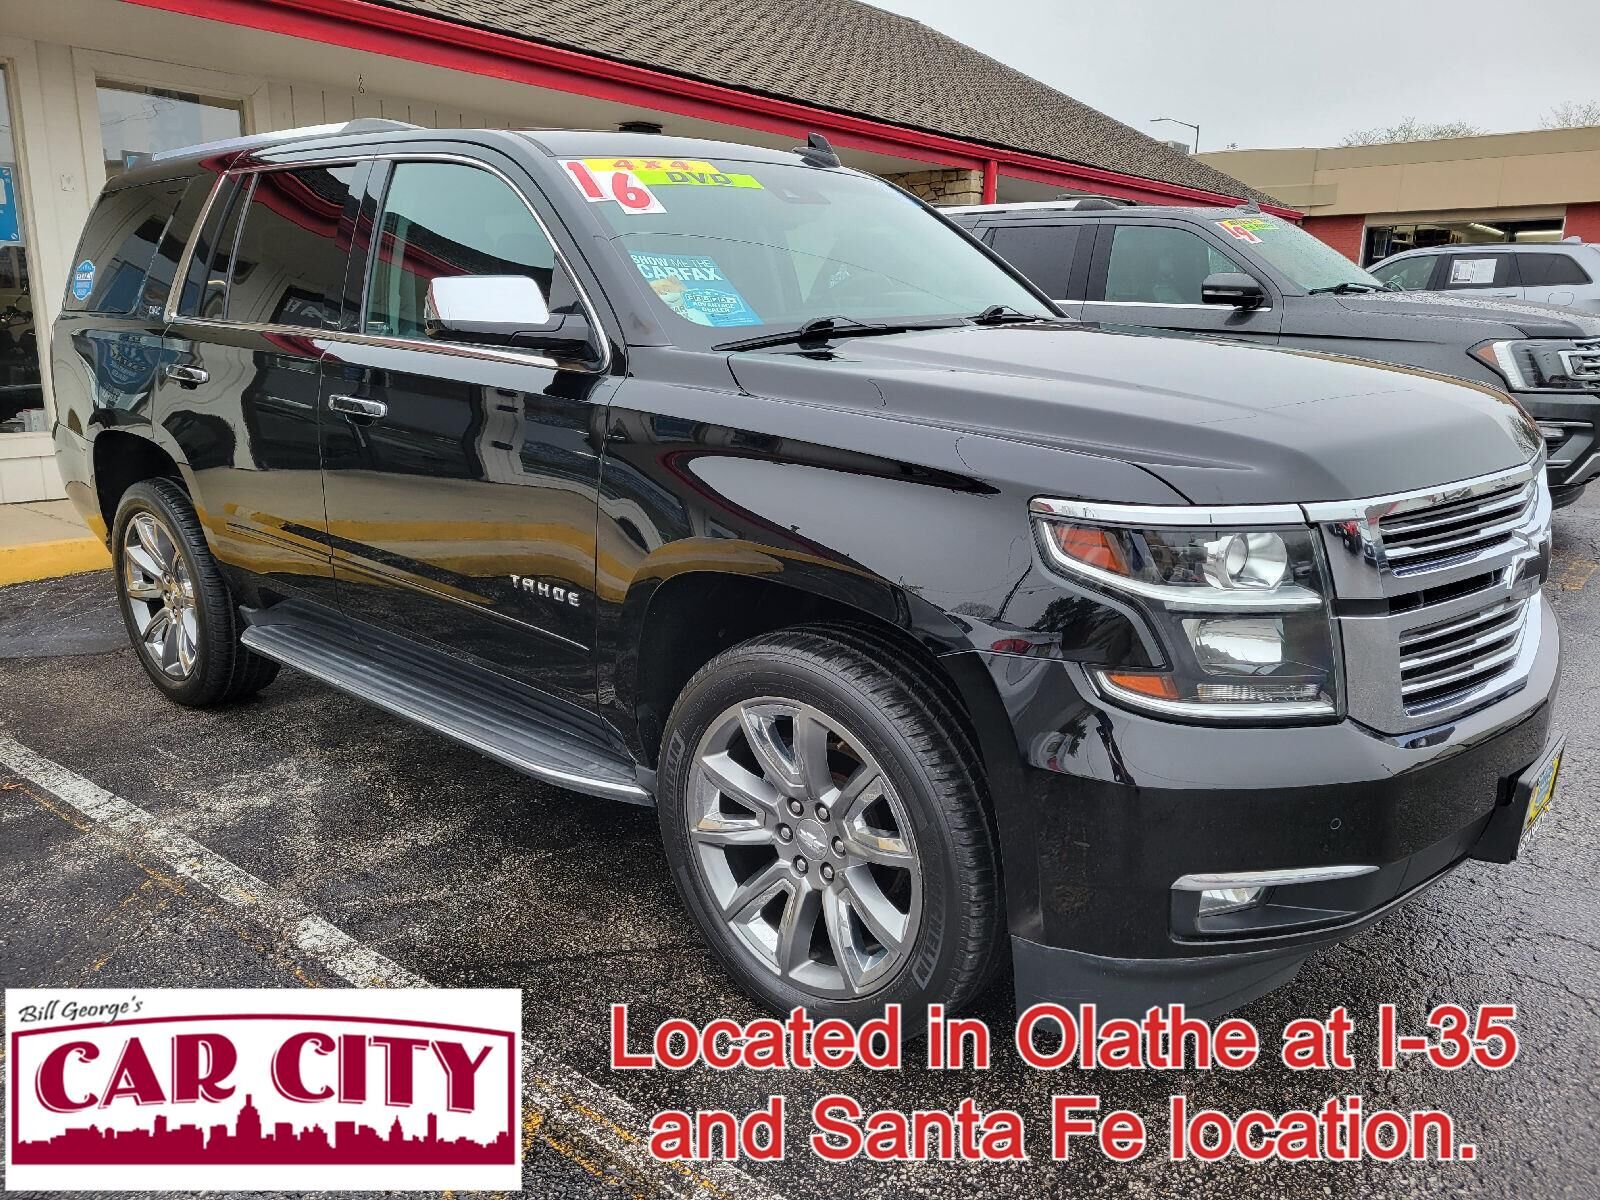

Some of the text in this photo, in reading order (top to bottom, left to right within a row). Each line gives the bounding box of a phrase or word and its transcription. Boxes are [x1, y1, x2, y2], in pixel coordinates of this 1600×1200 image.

[566, 161, 651, 209] 16
[665, 171, 734, 185] DVD
[630, 254, 714, 268] SHOW ME THE
[636, 263, 724, 281] CARFAX
[509, 574, 581, 607] TAHOE
